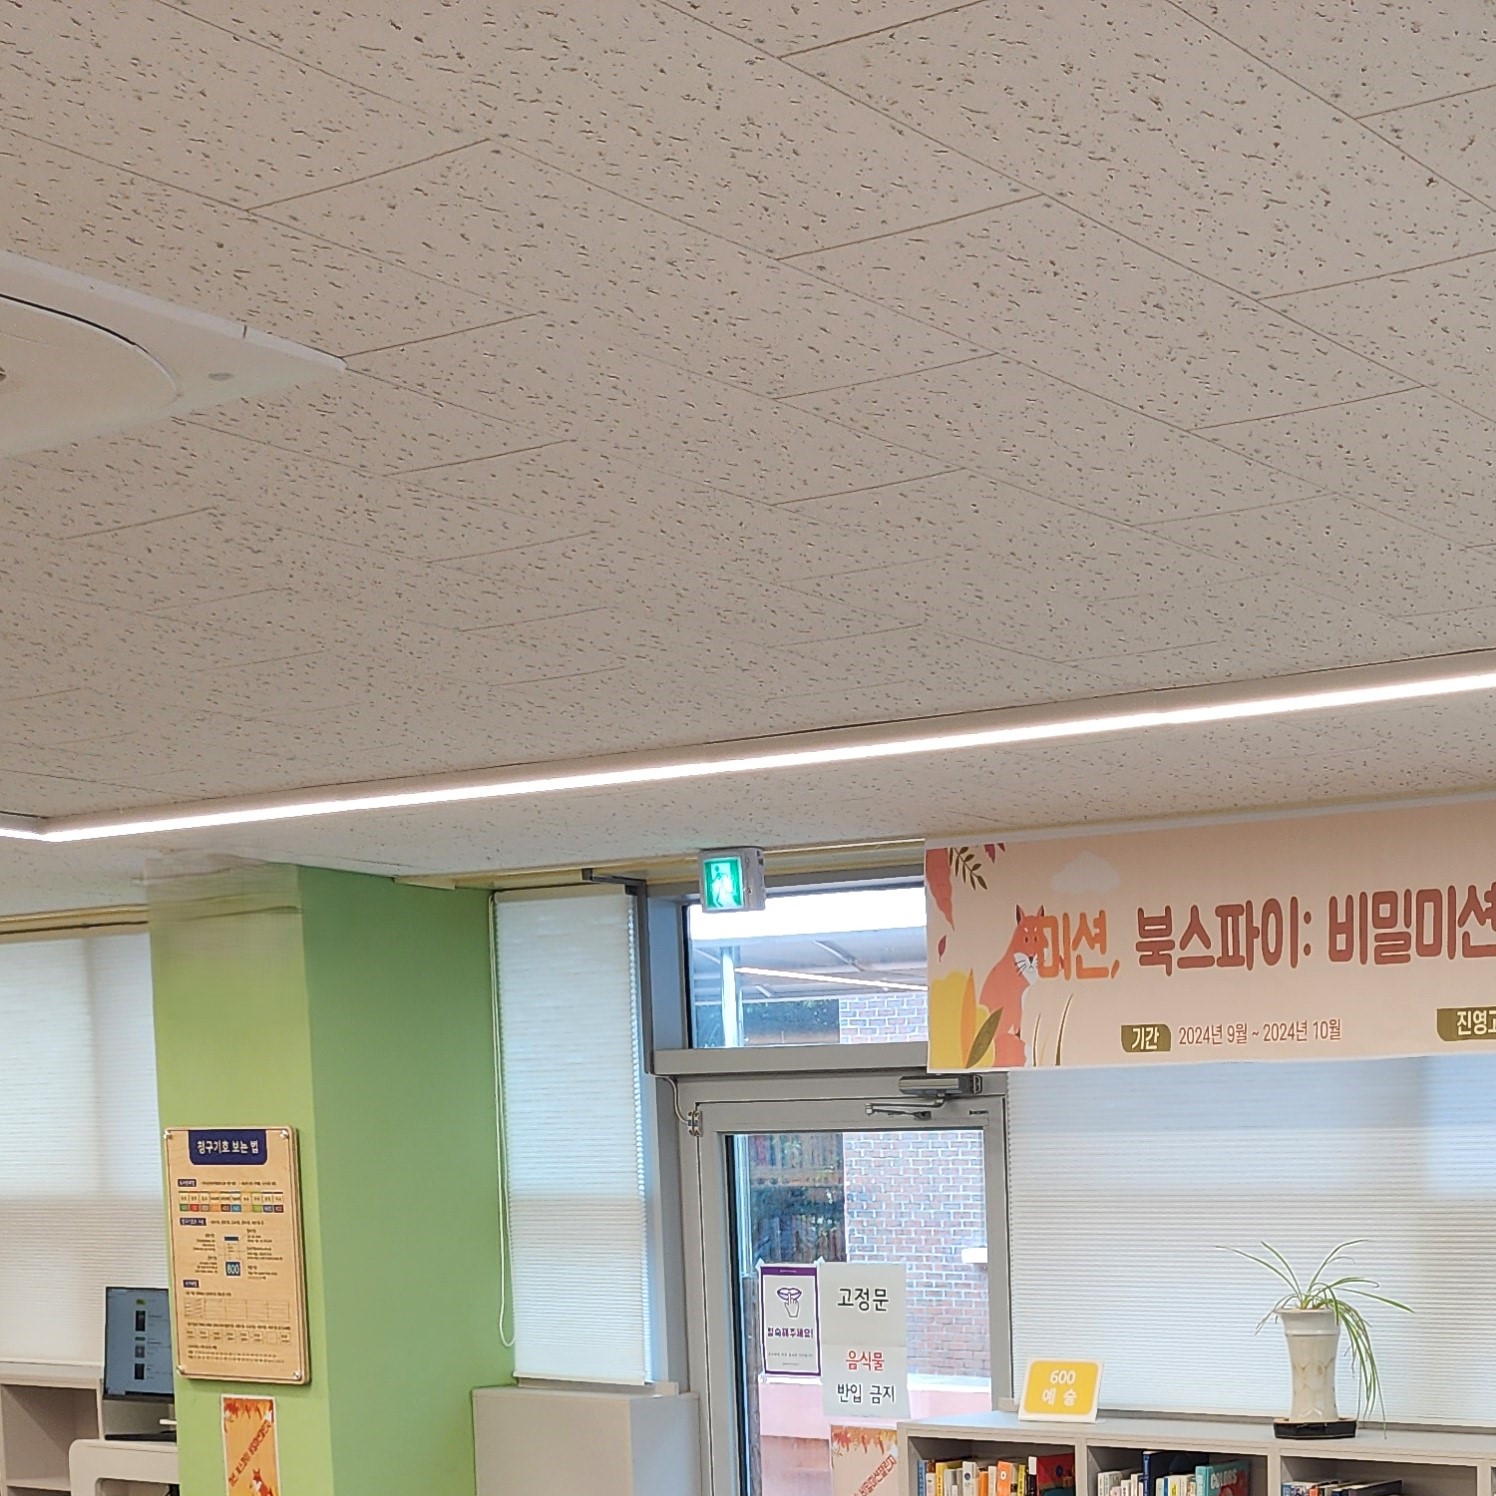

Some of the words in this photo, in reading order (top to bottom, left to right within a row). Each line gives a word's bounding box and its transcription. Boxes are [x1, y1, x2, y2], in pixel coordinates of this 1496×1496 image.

[1038, 909, 1120, 981] 미션,
[1135, 896, 1312, 977] 북스파이:
[1131, 1026, 1160, 1050] 기간
[1179, 1024, 1223, 1046] 2024년
[1227, 1023, 1248, 1045] 9월
[1263, 1021, 1307, 1042] 2024년
[1313, 1018, 1342, 1041] 10월
[232, 1140, 248, 1154] 보는
[837, 1287, 889, 1312] 고정문
[846, 1350, 885, 1372] 음식물
[1050, 1370, 1076, 1384] 600
[837, 1383, 862, 1404] 반입
[870, 1384, 895, 1404] 금지
